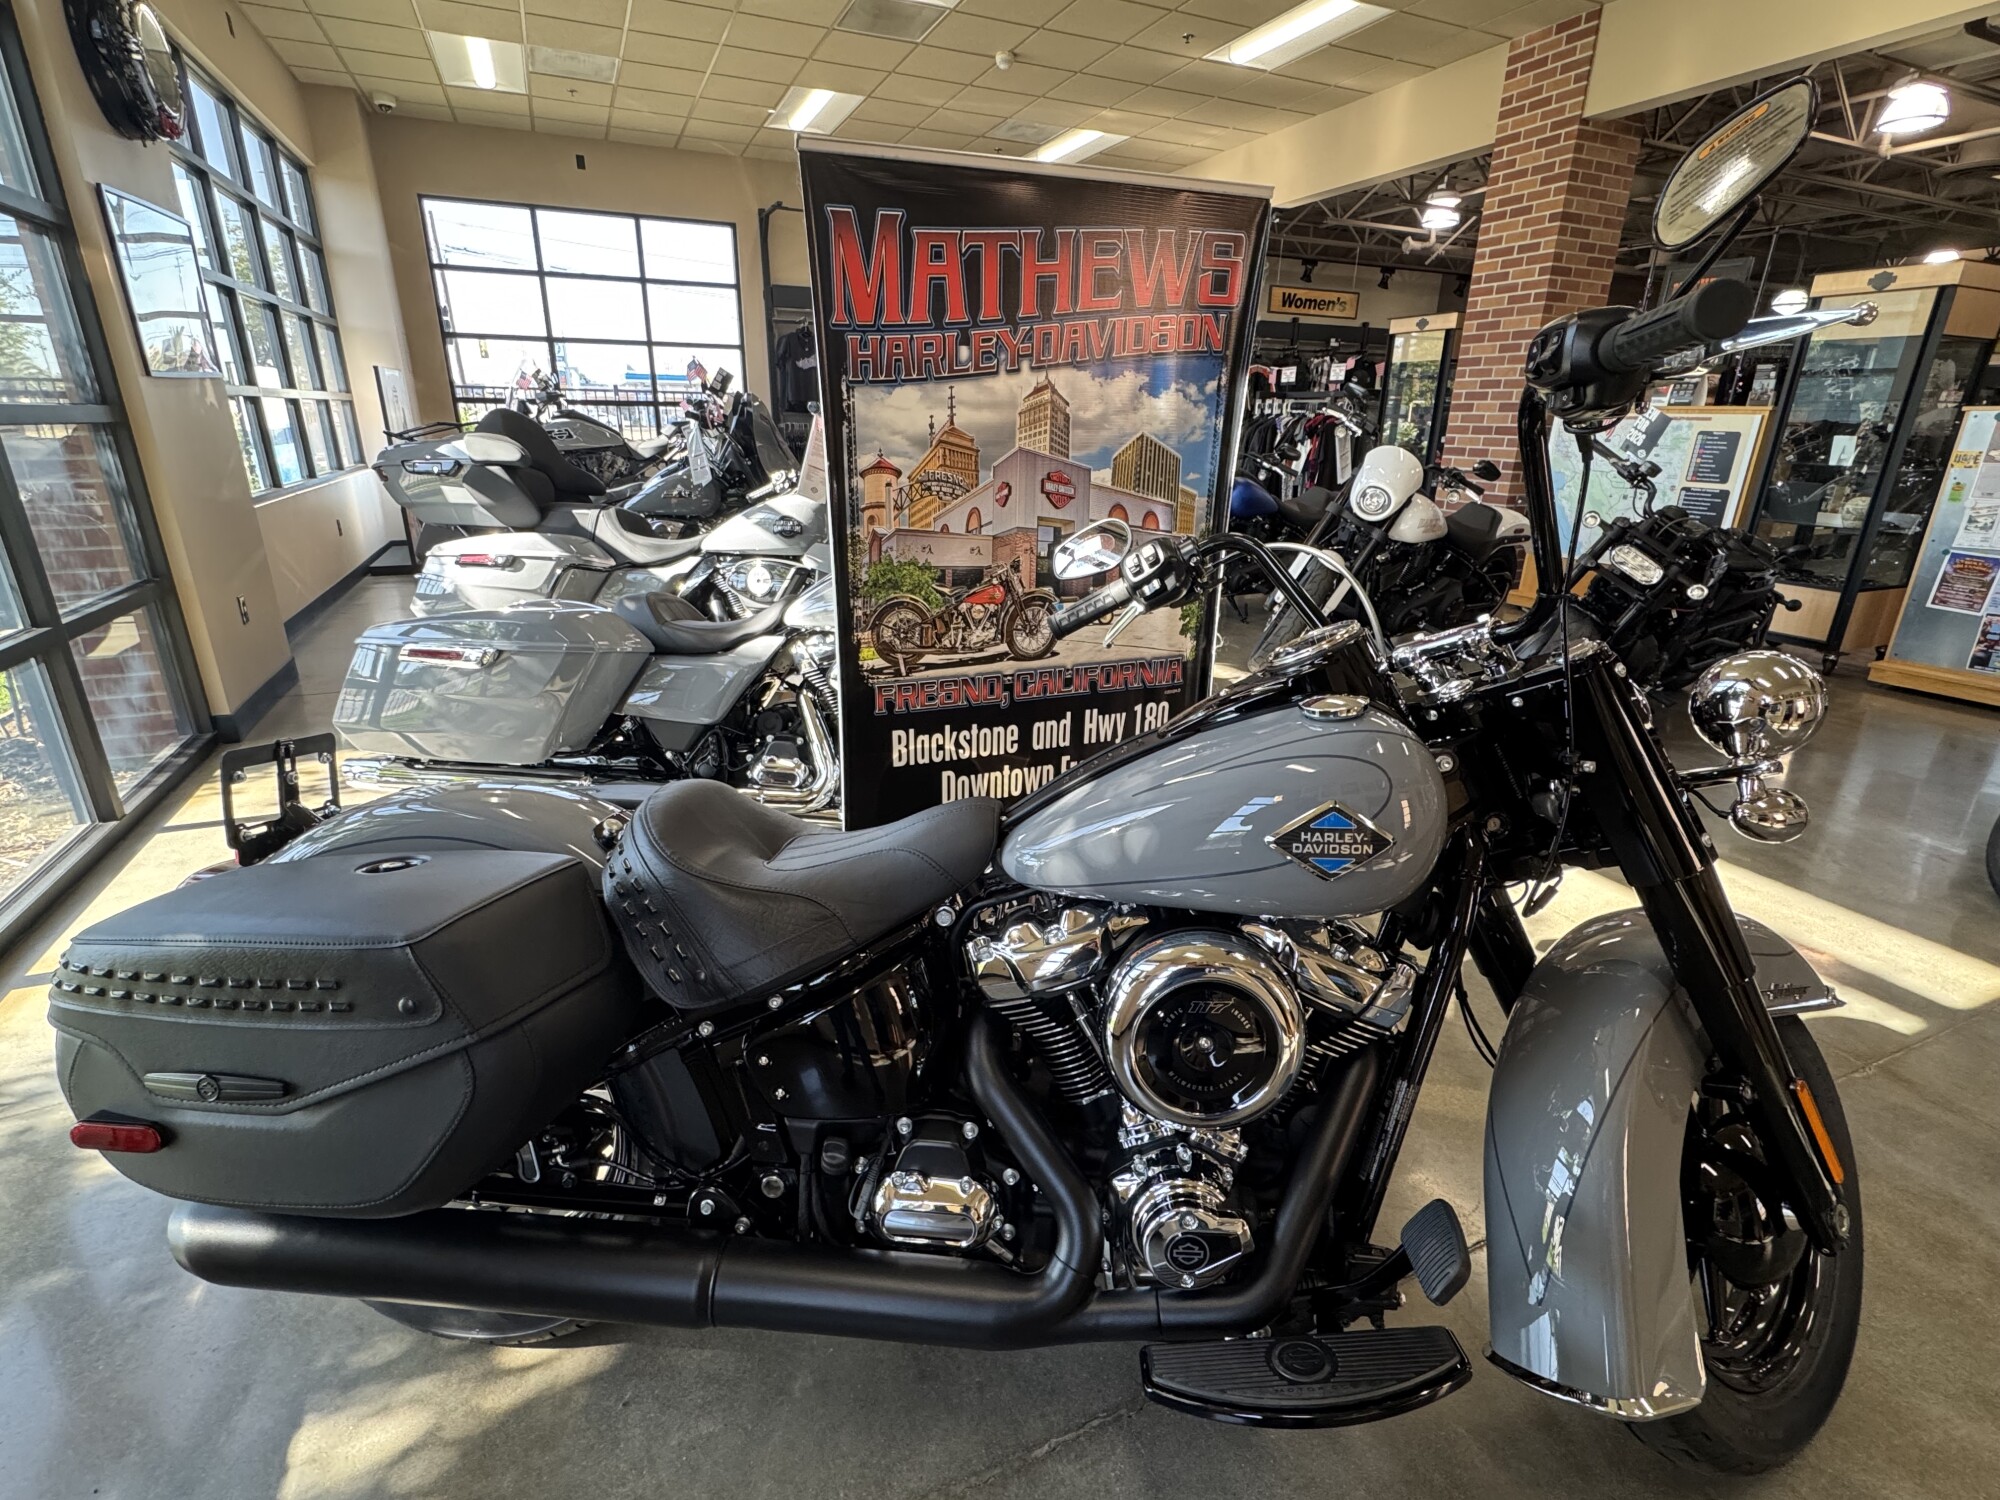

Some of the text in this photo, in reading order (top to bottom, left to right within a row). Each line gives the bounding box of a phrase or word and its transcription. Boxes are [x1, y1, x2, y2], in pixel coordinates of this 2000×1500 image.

[826, 205, 1247, 328] MATHEWS
[1281, 291, 1348, 313] Women's
[845, 313, 1229, 382] HARLEY-DAVIDSON
[1633, 415, 1650, 432] FOR
[1626, 428, 1647, 447] 2026
[929, 470, 964, 485] FRESNO
[874, 658, 1184, 714] FRESNO, CALIFORNIA
[892, 724, 1019, 768] Blackstone
[1032, 711, 1072, 751] and
[1083, 708, 1127, 745] Hwy
[1134, 701, 1170, 736] 180
[941, 764, 1055, 804] Downtown
[1292, 843, 1374, 855] DAVIDSON
[1300, 832, 1369, 843] HARLEY-
[1162, 997, 1252, 1030] CUBIC 117 INCHES
